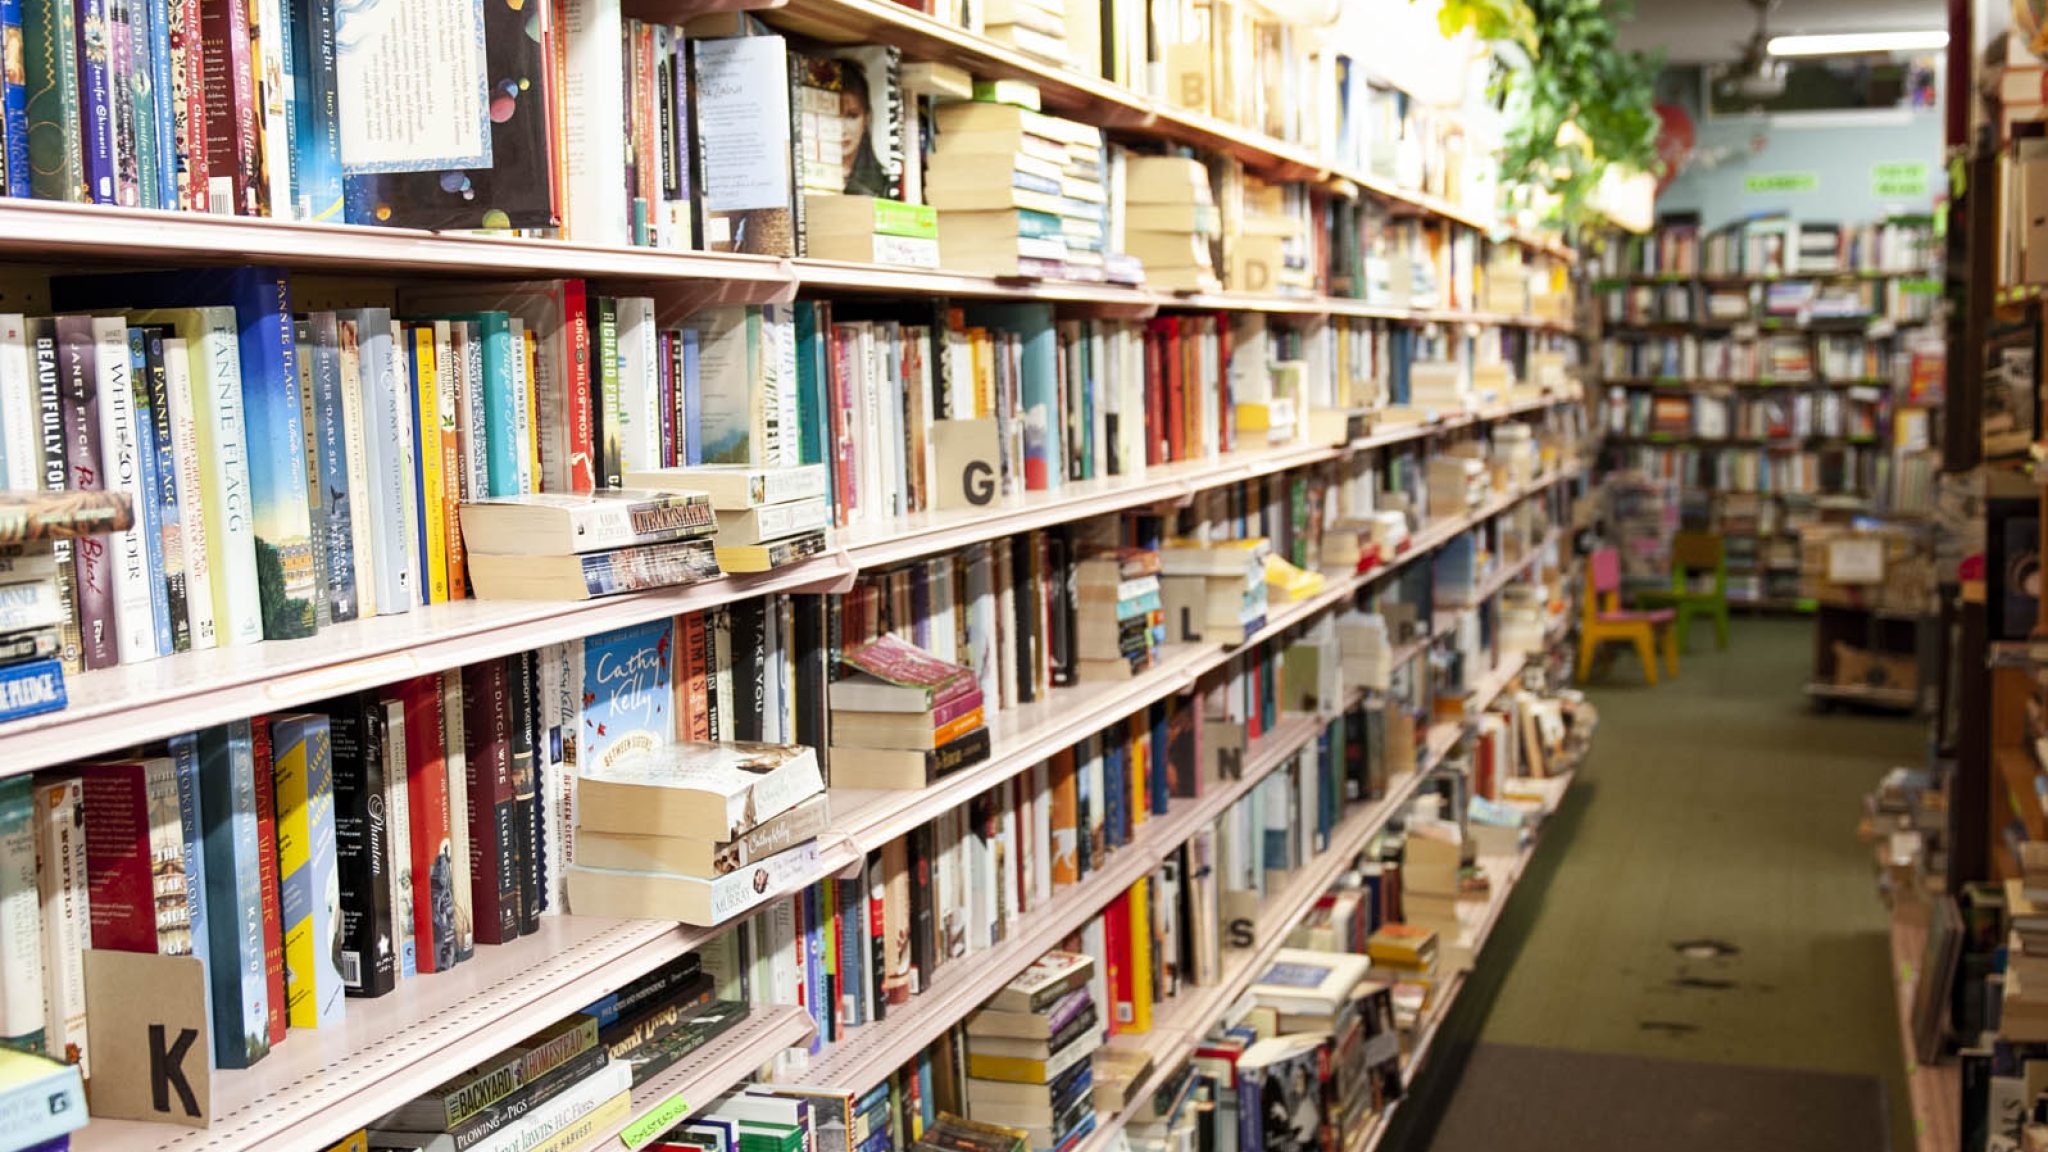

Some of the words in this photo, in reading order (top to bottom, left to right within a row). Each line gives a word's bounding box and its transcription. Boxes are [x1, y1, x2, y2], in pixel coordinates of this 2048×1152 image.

[132, 2, 145, 56] ROBIN
[234, 0, 247, 49] ottoms
[321, 6, 332, 23] at
[65, 41, 74, 67] THE
[321, 28, 334, 72] night
[67, 73, 77, 108] LAST
[93, 64, 106, 101] Jennifer
[191, 54, 202, 99] Jennifer
[239, 62, 250, 100] Mark
[326, 90, 336, 118] lucy
[69, 111, 81, 178] RUNAWAY
[96, 104, 109, 160] Chiaverini
[138, 110, 150, 154] Jennifer
[193, 103, 204, 161] Chiaverini
[241, 106, 254, 177] Childress
[1245, 259, 1270, 290] D
[275, 279, 289, 346] FANNIE
[282, 349, 297, 409] FLAGG
[574, 310, 586, 350] SONGS
[603, 311, 617, 378] RICHARD
[37, 337, 63, 454] BEAUTIFULLY
[70, 342, 84, 399] JANET
[213, 326, 234, 432] FANNIE
[303, 368, 313, 419] THE
[452, 350, 464, 402] delicacy
[576, 361, 587, 405] WILLOW
[152, 366, 171, 441] FANNIE
[321, 351, 334, 401] SILVER
[328, 449, 338, 476] SEA
[578, 408, 589, 446] FROST
[605, 383, 619, 421] FORD
[76, 406, 89, 458] FITCH
[140, 413, 154, 472] FANNIE
[160, 442, 178, 511] FLAGG
[306, 432, 319, 489] LIST
[962, 460, 996, 506] G
[144, 475, 159, 526] FLAGG
[222, 441, 242, 533] FLAGG
[754, 622, 765, 668] TAKE
[1180, 606, 1202, 642] L
[596, 647, 661, 691] Cathy
[754, 672, 765, 713] YOU
[494, 690, 505, 743] DUTCH
[608, 673, 654, 727] Kelly
[523, 706, 534, 746] Keillor
[496, 747, 507, 784] WIFE
[1217, 747, 1243, 781] N
[367, 793, 387, 876] Phantom
[501, 807, 511, 848] ELLEN
[258, 836, 274, 923] WINTER
[503, 850, 512, 888] KEITH
[1227, 917, 1256, 949] S
[147, 1023, 203, 1119] K
[458, 1068, 511, 1118] BACKYARD
[526, 1027, 583, 1080] HOMESTEAD
[457, 1115, 501, 1150] PLOWING
[506, 1099, 529, 1120] PIGS
